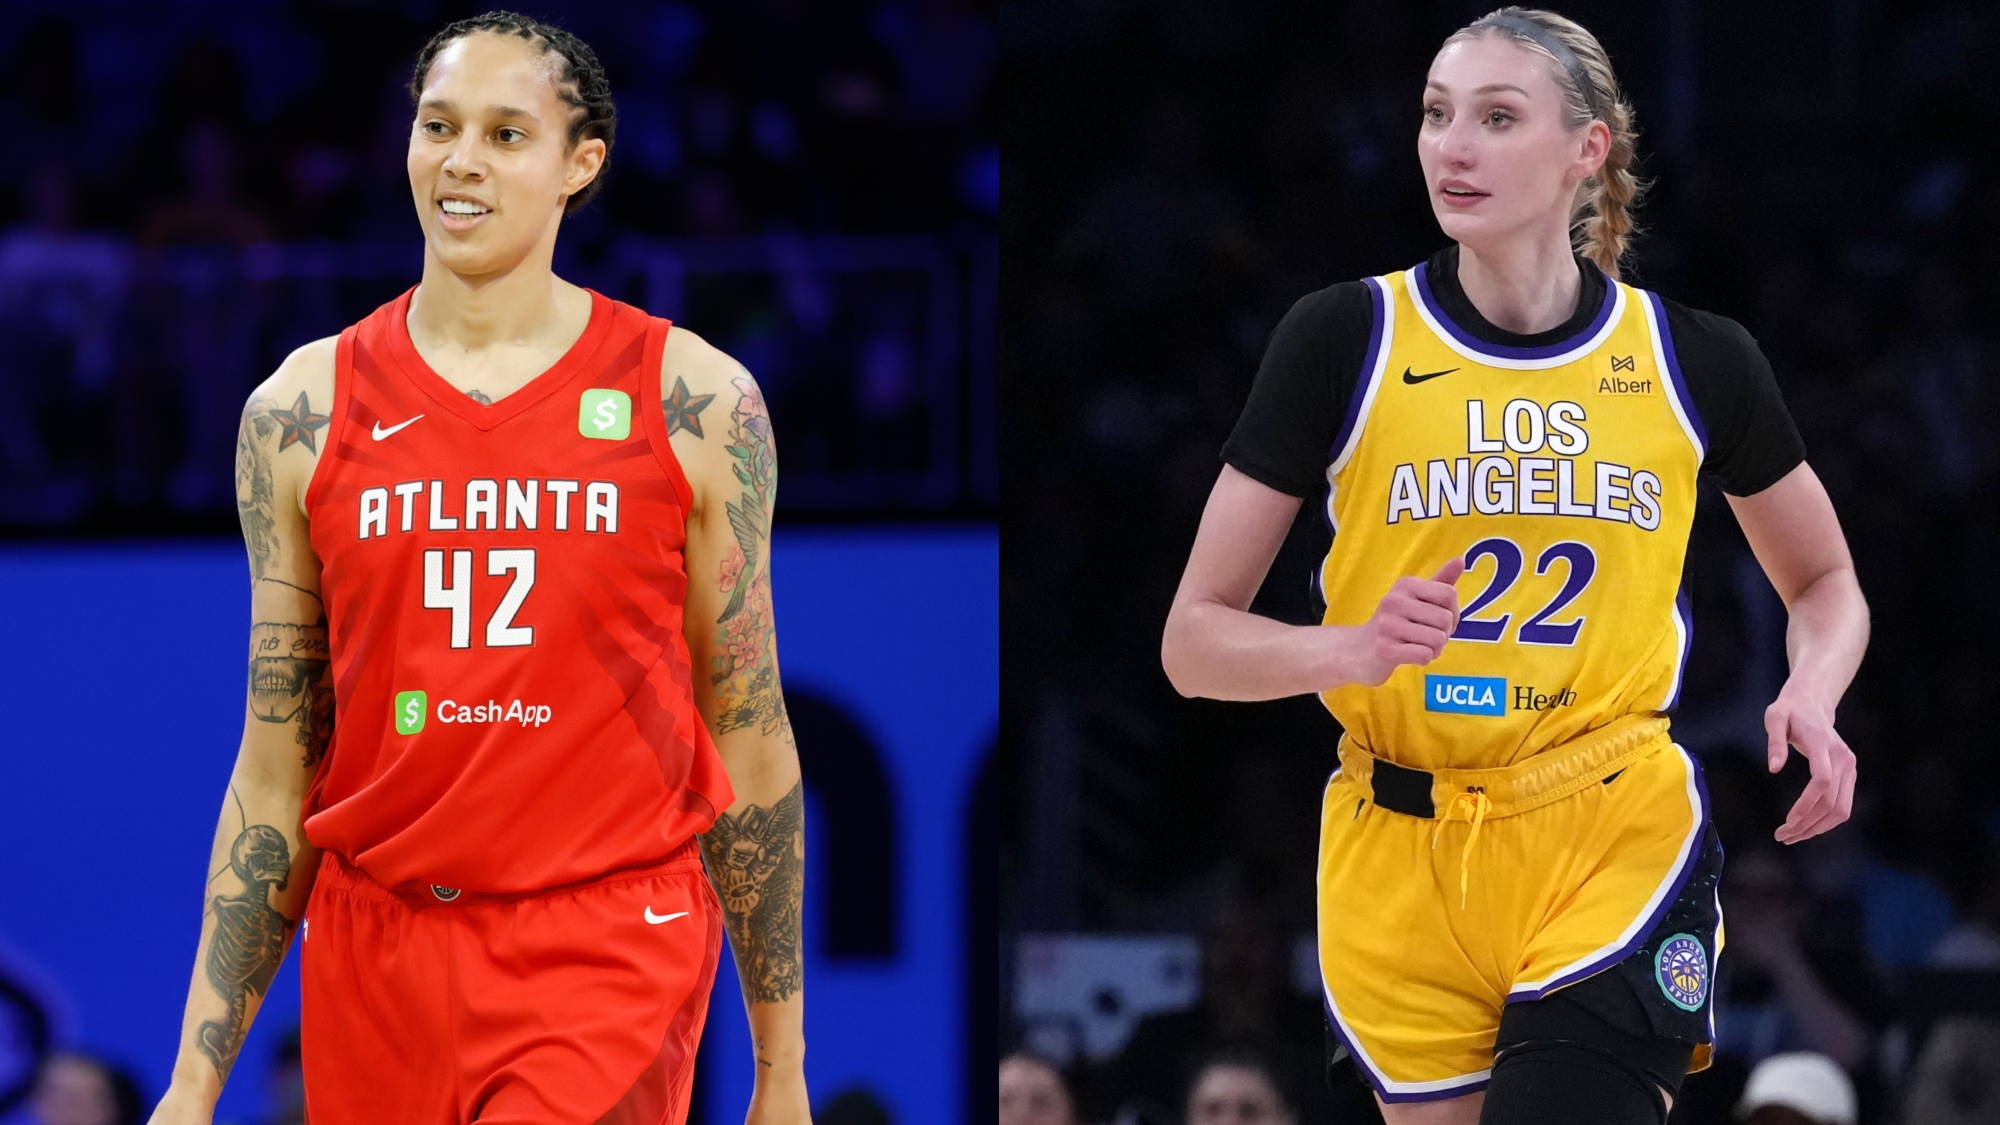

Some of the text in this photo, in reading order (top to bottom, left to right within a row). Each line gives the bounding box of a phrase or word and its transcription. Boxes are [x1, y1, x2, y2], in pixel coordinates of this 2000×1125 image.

[1598, 377, 1652, 394] Albert
[1466, 398, 1589, 456] LOS
[1386, 456, 1662, 531] ANGELES
[358, 477, 620, 541] ATLANTA
[422, 547, 537, 649] 42
[1448, 536, 1598, 647] 22
[259, 636, 281, 653] no
[1435, 683, 1578, 711] UCLA Healh
[436, 699, 503, 724] Cash
[504, 698, 552, 728] App
[1661, 948, 1673, 973] LOS
[1668, 985, 1703, 1004] SPARKS
